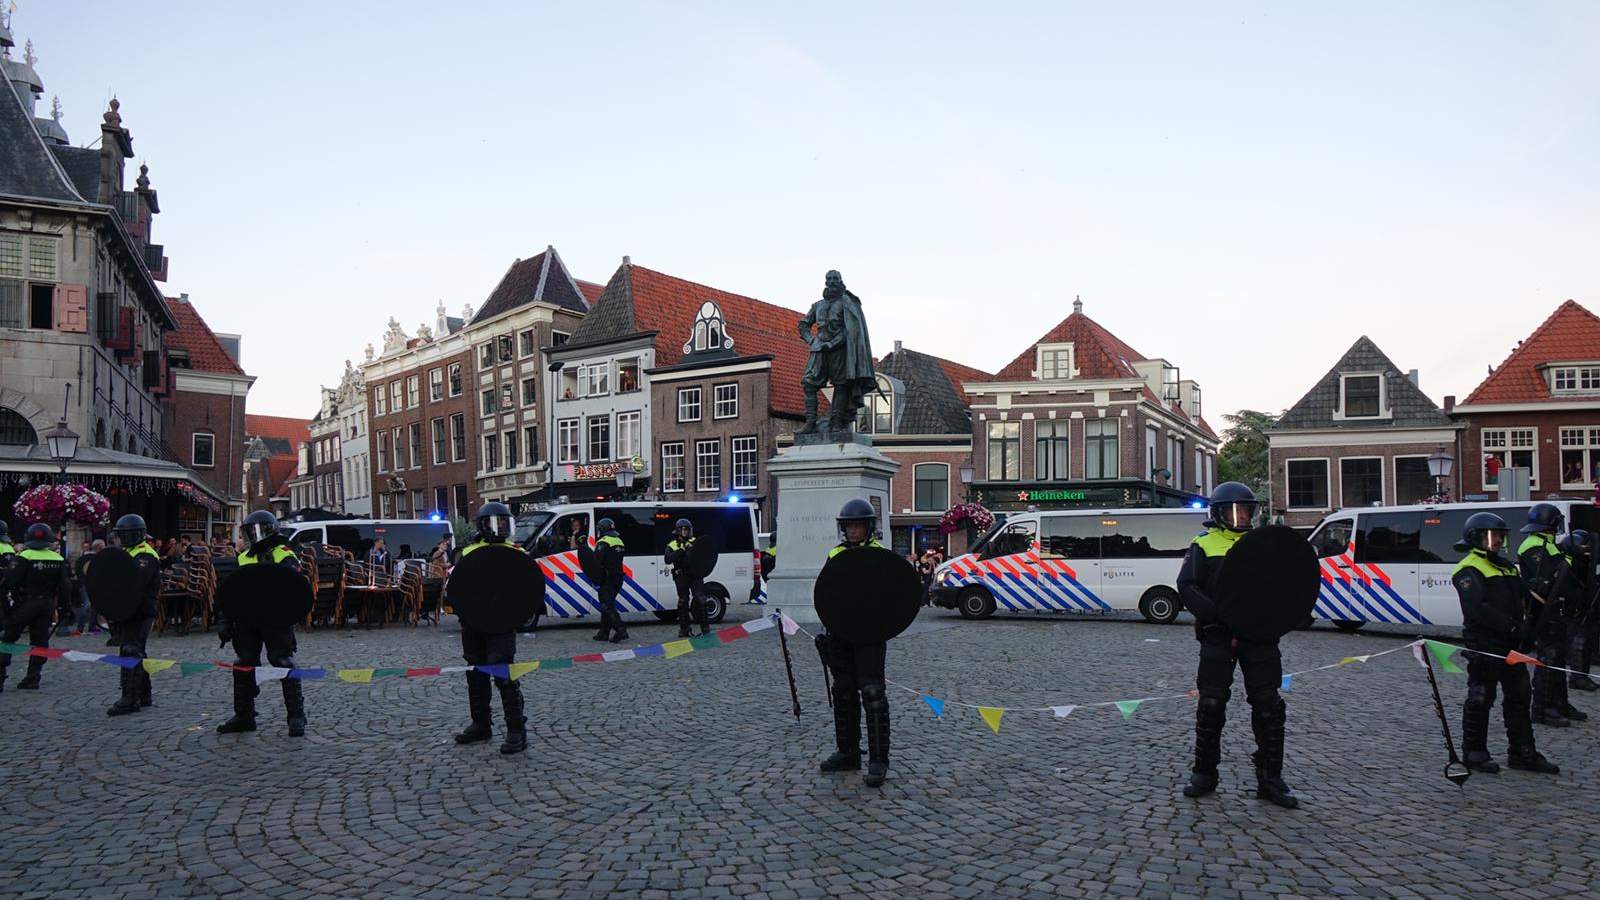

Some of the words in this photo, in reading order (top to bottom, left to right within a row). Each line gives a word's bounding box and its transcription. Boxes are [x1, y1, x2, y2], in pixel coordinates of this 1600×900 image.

[1030, 489, 1085, 500] Heineken
[1103, 568, 1135, 579] POLITIE
[1421, 576, 1452, 588] POLITI
